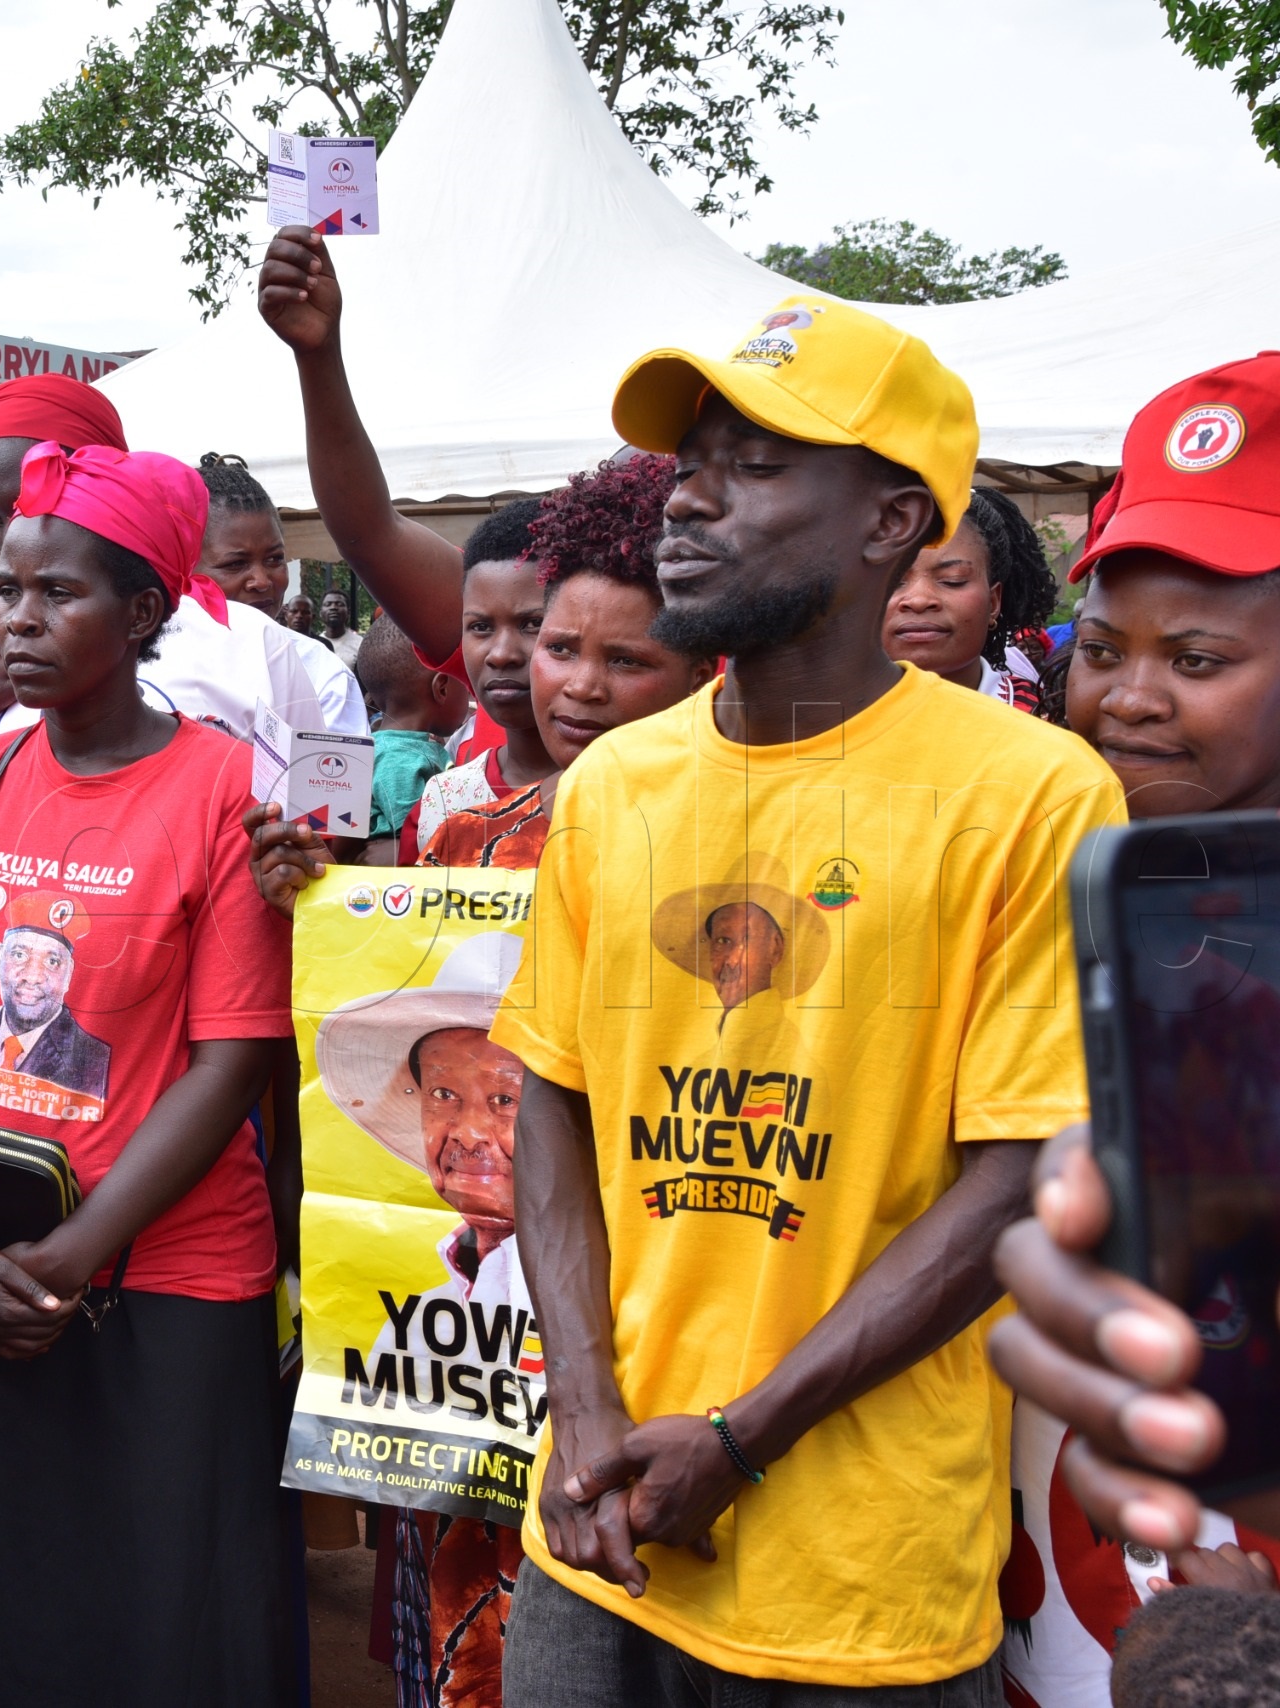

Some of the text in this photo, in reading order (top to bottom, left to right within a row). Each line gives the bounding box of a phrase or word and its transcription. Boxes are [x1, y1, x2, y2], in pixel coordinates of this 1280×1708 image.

[731, 348, 795, 365] MUSEVENI
[1180, 410, 1236, 428] PEOPLE POWER
[1192, 454, 1221, 466] POWER
[302, 733, 343, 742] MEMBERSHIP
[308, 779, 352, 788] NATIONAL
[64, 862, 134, 887] SAULO
[19, 1076, 37, 1087] LC5
[22, 1088, 59, 1104] NORTH
[330, 1428, 508, 1483] PROTECTING
[295, 1457, 312, 1471] AS
[315, 1461, 334, 1475] WE
[337, 1465, 372, 1482] MAKE
[375, 1471, 383, 1483] A
[386, 1473, 465, 1497] QUALITATIVE
[469, 1484, 497, 1501] LEAP
[497, 1493, 518, 1509] INTO
